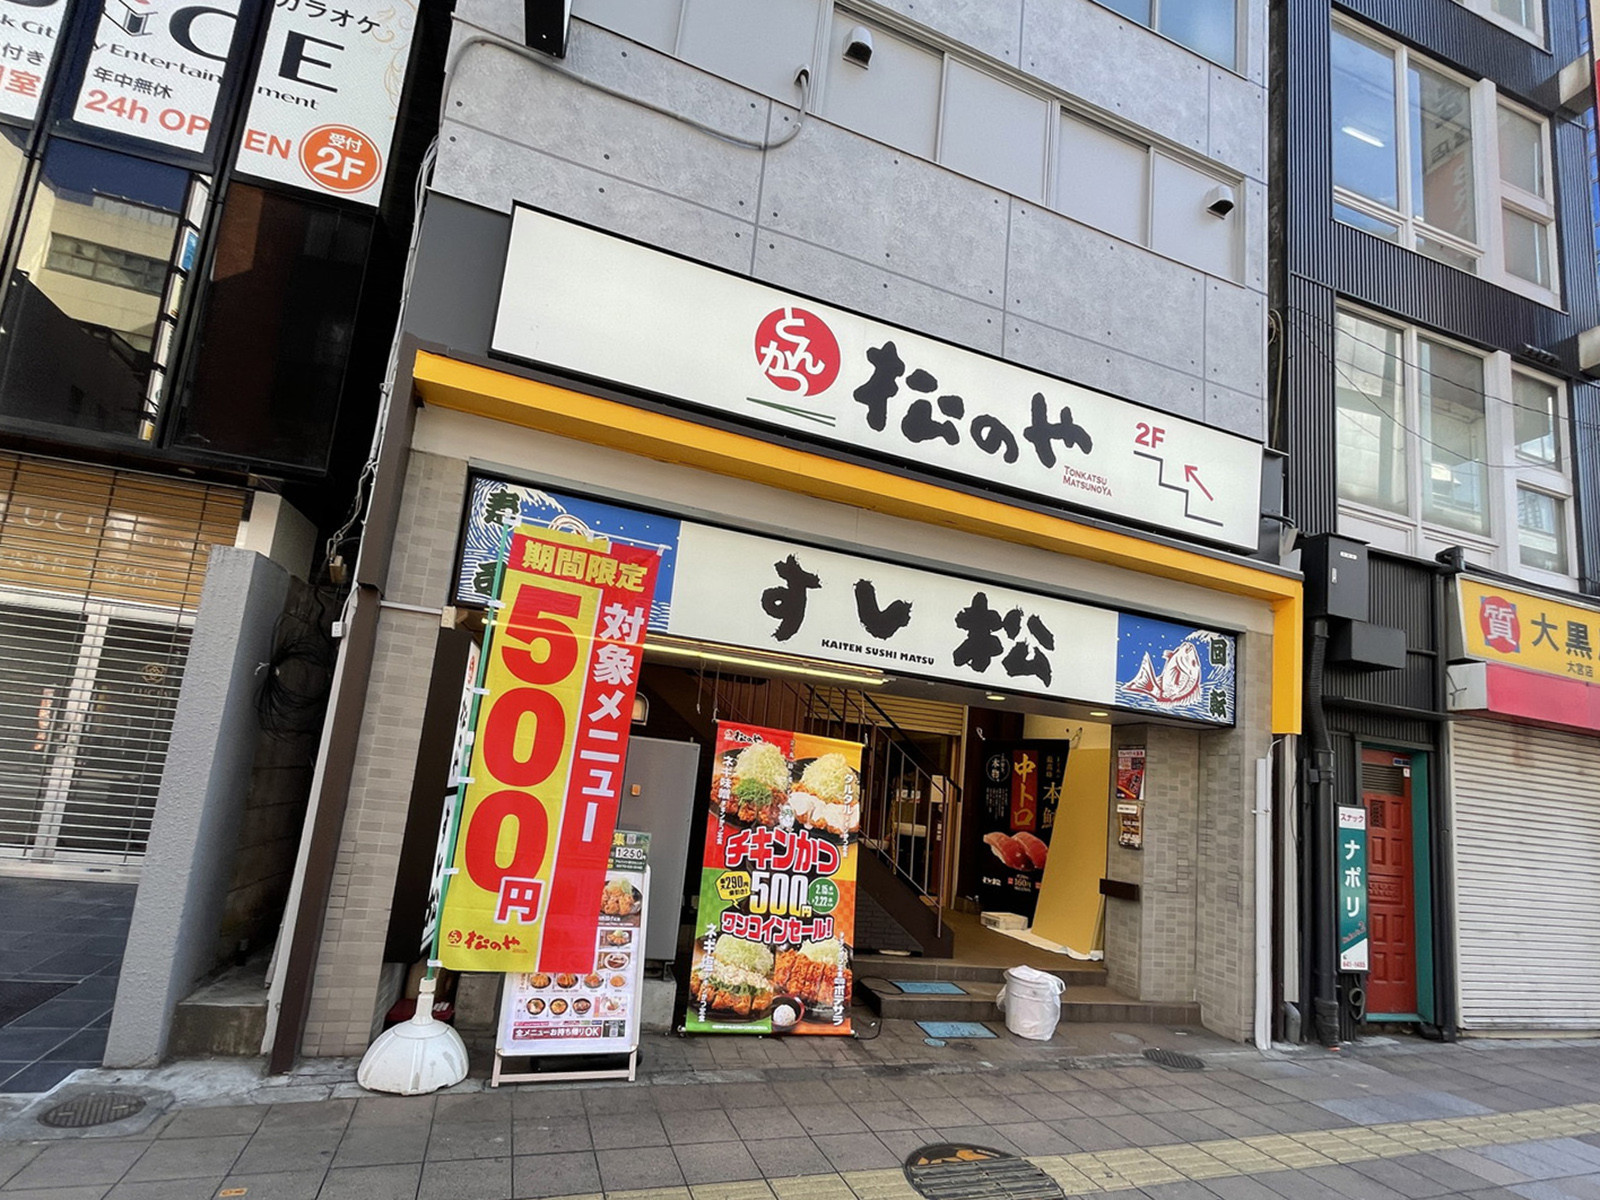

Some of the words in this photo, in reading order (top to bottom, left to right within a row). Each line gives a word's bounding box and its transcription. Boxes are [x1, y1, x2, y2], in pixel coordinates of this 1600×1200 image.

[2, 42, 45, 67] 付き
[0, 66, 41, 98] 室
[93, 66, 173, 100] 年中無休
[84, 89, 149, 124] 24h
[328, 132, 363, 154] 受付
[313, 146, 366, 181] 2F
[853, 341, 1093, 468] 松のや
[1134, 422, 1165, 449] 2F
[1062, 475, 1112, 497] MATSUNOYA
[1063, 465, 1107, 486] TONKATSU
[522, 539, 648, 594] 期間限定
[761, 553, 1055, 688] すし松
[1484, 603, 1517, 645] 質
[1530, 612, 1600, 661] 大黒
[821, 638, 863, 654] KAITEN
[865, 646, 898, 660] SUSHI
[899, 652, 936, 666] MATSU
[580, 602, 645, 843] 対象メニュー
[1013, 752, 1037, 827] 中トロ
[1341, 812, 1364, 823] スナック
[616, 847, 643, 860] 1250
[725, 826, 840, 875] チキンかつ
[749, 871, 813, 918] 500円
[1343, 839, 1362, 918] ナポリ
[464, 930, 521, 951] 松のや
[721, 911, 834, 944] ワンコインセール!
